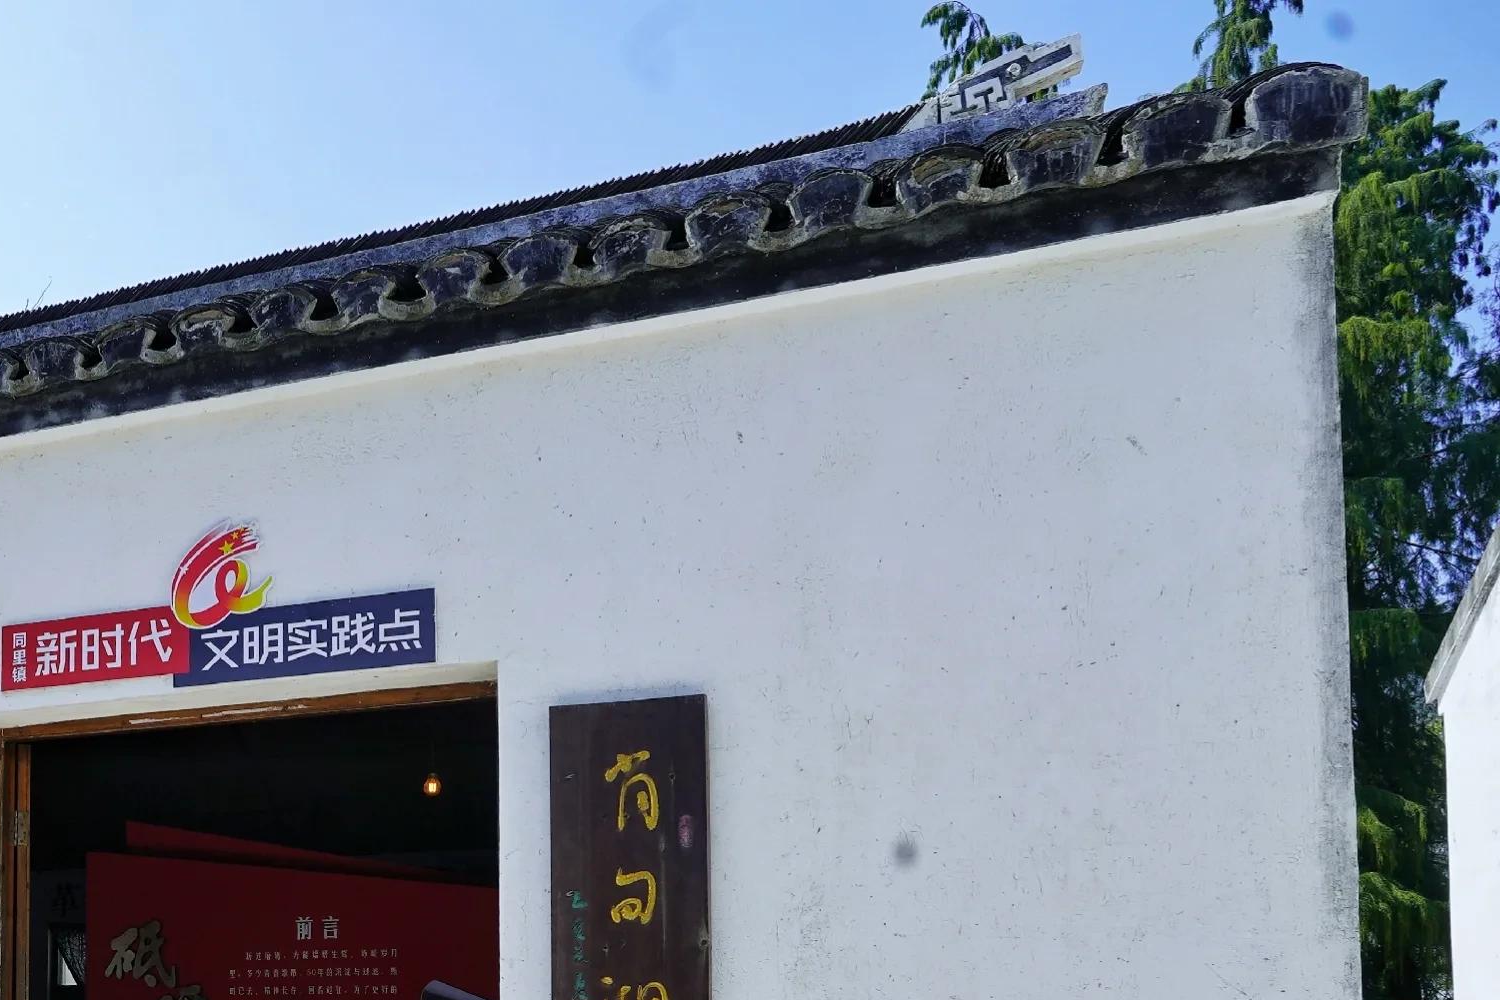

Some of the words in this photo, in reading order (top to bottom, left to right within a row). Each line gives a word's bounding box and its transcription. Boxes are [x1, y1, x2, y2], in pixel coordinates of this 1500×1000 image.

[12, 631, 27, 684] 同里镇
[34, 619, 173, 677] 新时代
[200, 607, 422, 672] 文明实践点
[295, 915, 340, 941] 前言
